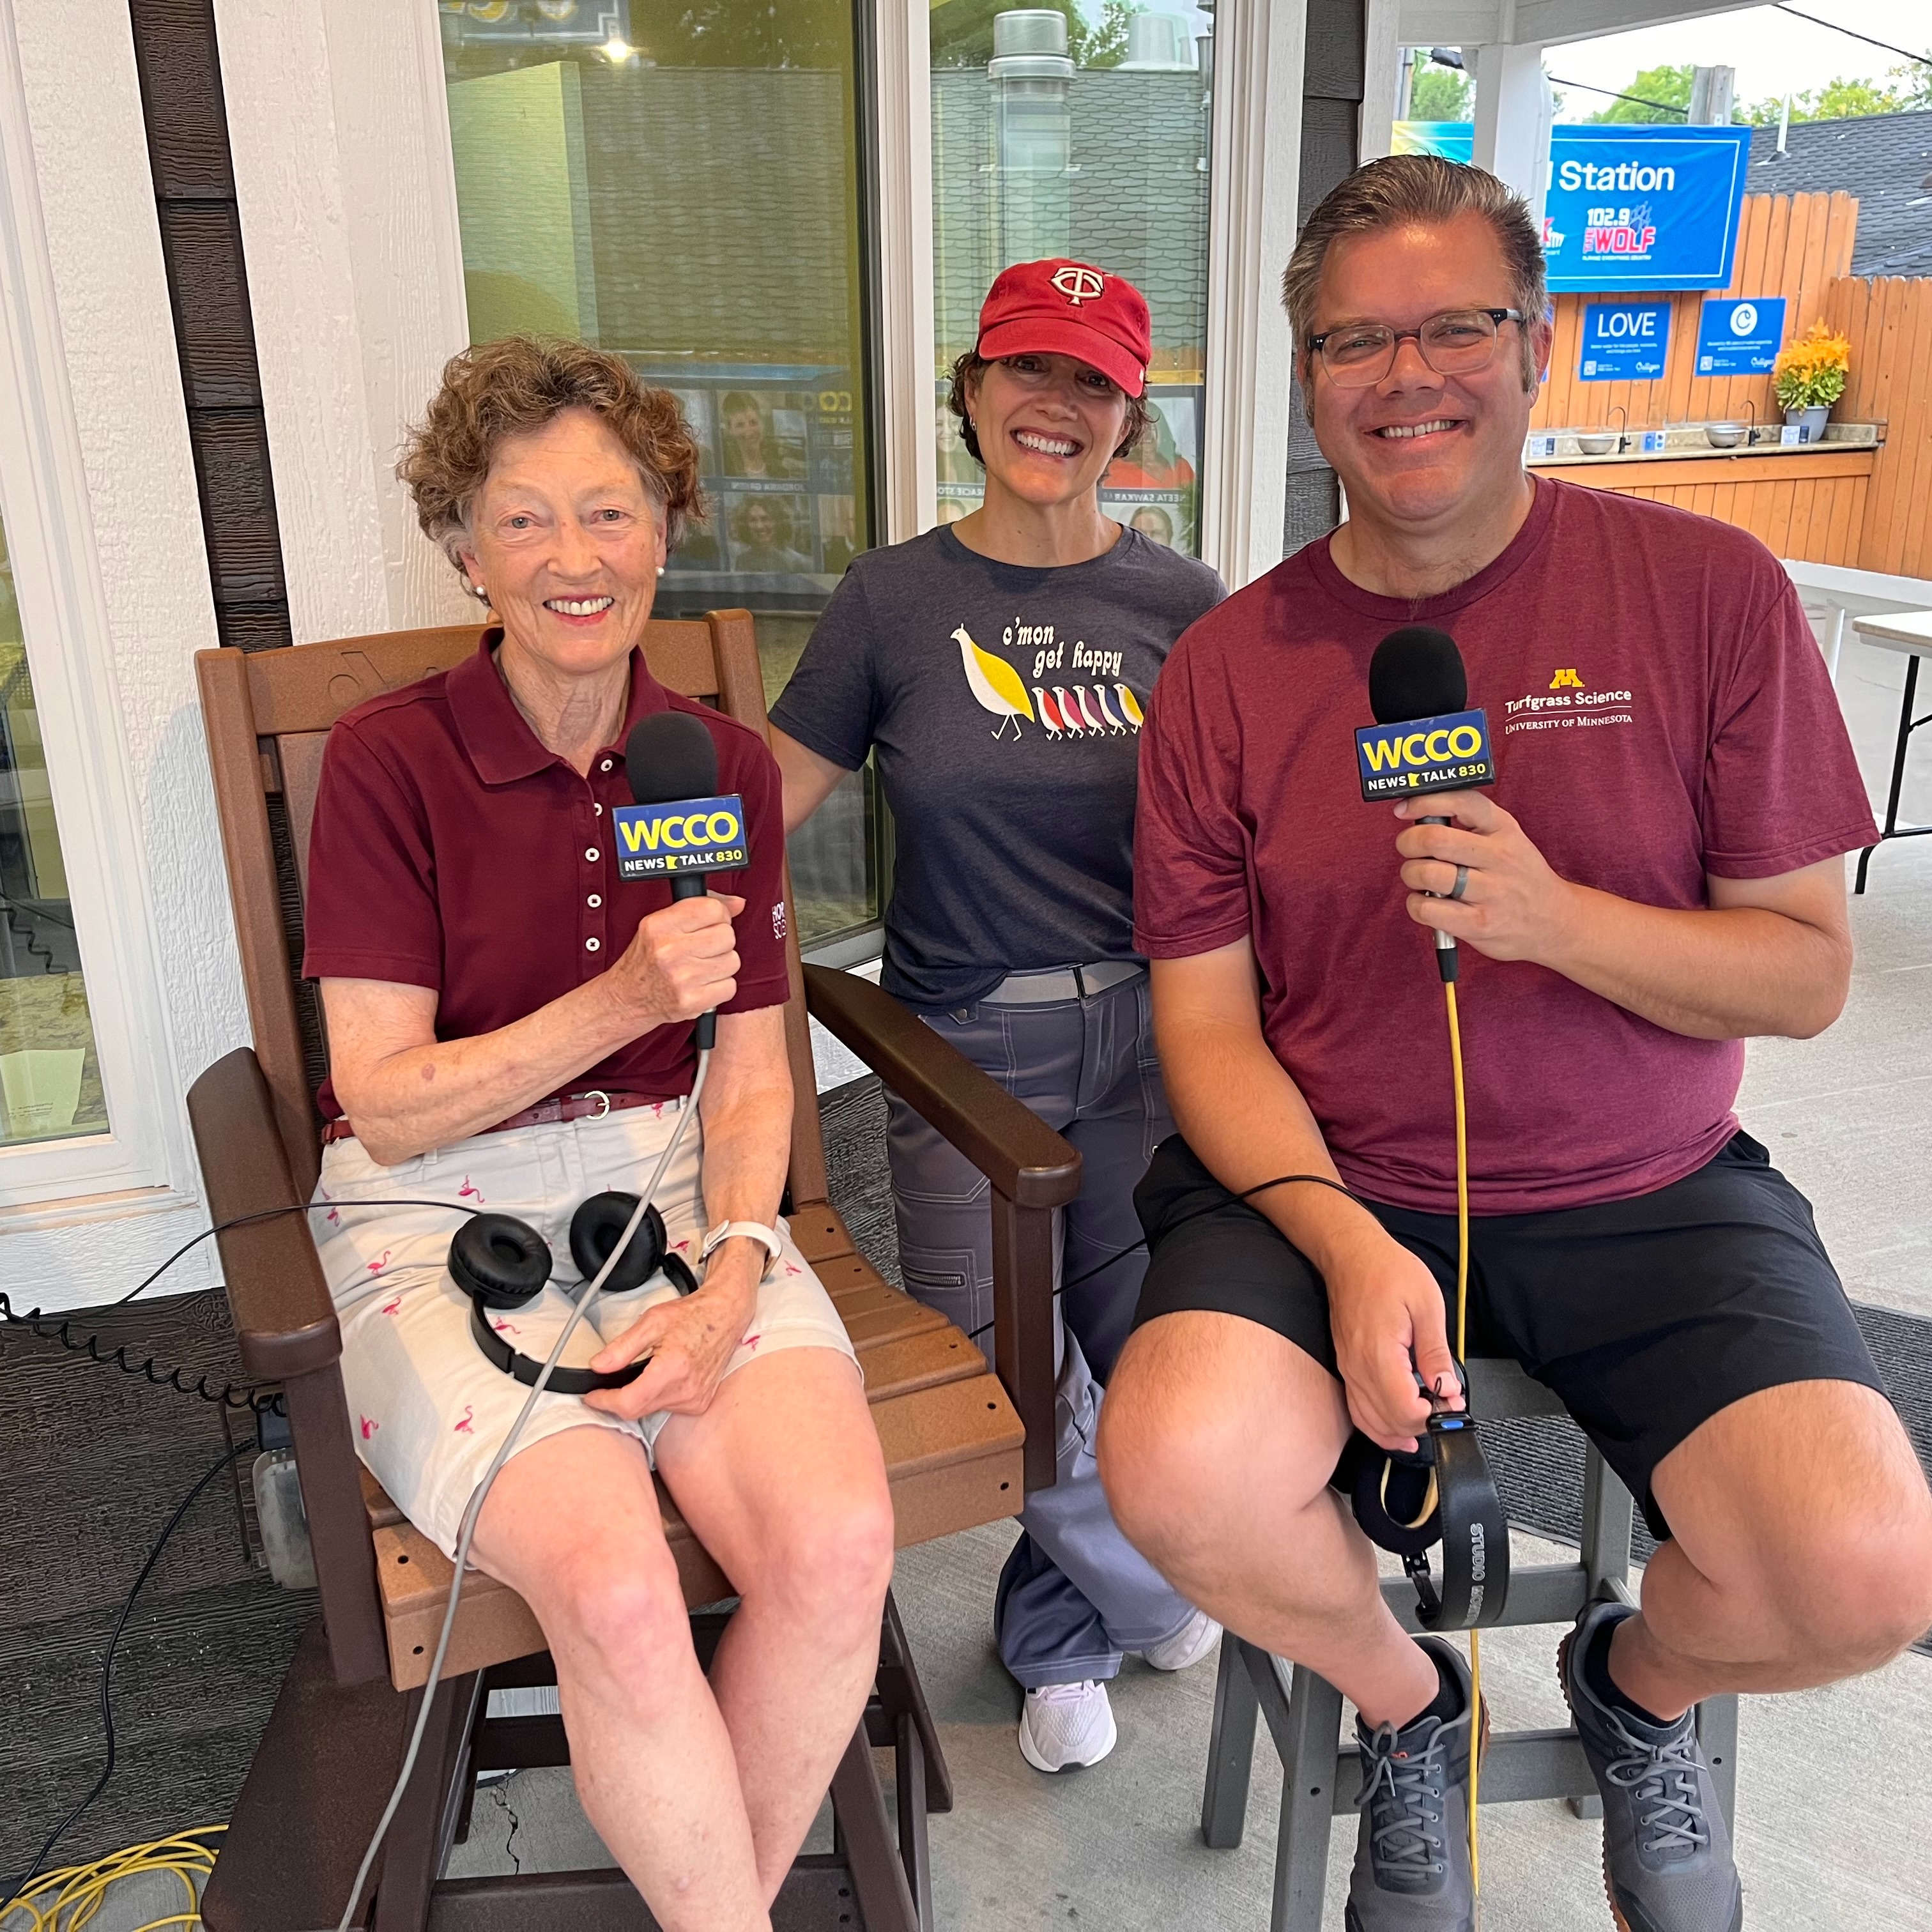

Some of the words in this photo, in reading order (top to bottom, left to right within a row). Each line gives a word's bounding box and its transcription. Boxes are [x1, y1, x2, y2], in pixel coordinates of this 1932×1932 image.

[1559, 160, 1675, 191] Station
[1587, 208, 1630, 226] 102.9
[1595, 227, 1657, 254] WOLF
[1597, 312, 1657, 337] LOVE
[1002, 616, 1054, 646] c'mon
[1032, 641, 1065, 678] get
[1072, 640, 1123, 677] happy
[1505, 694, 1572, 714] Turfgrass
[1575, 690, 1632, 705] Science
[1361, 725, 1483, 772] WCCO
[1367, 775, 1407, 791] NEWS
[1421, 767, 1457, 783] TALK
[1458, 763, 1487, 777] 830
[618, 811, 739, 853] WCCO
[624, 857, 665, 872] NEWS
[679, 852, 715, 867] TALK
[716, 849, 743, 862] 830
[1469, 1522, 1486, 1582] STUDIO
